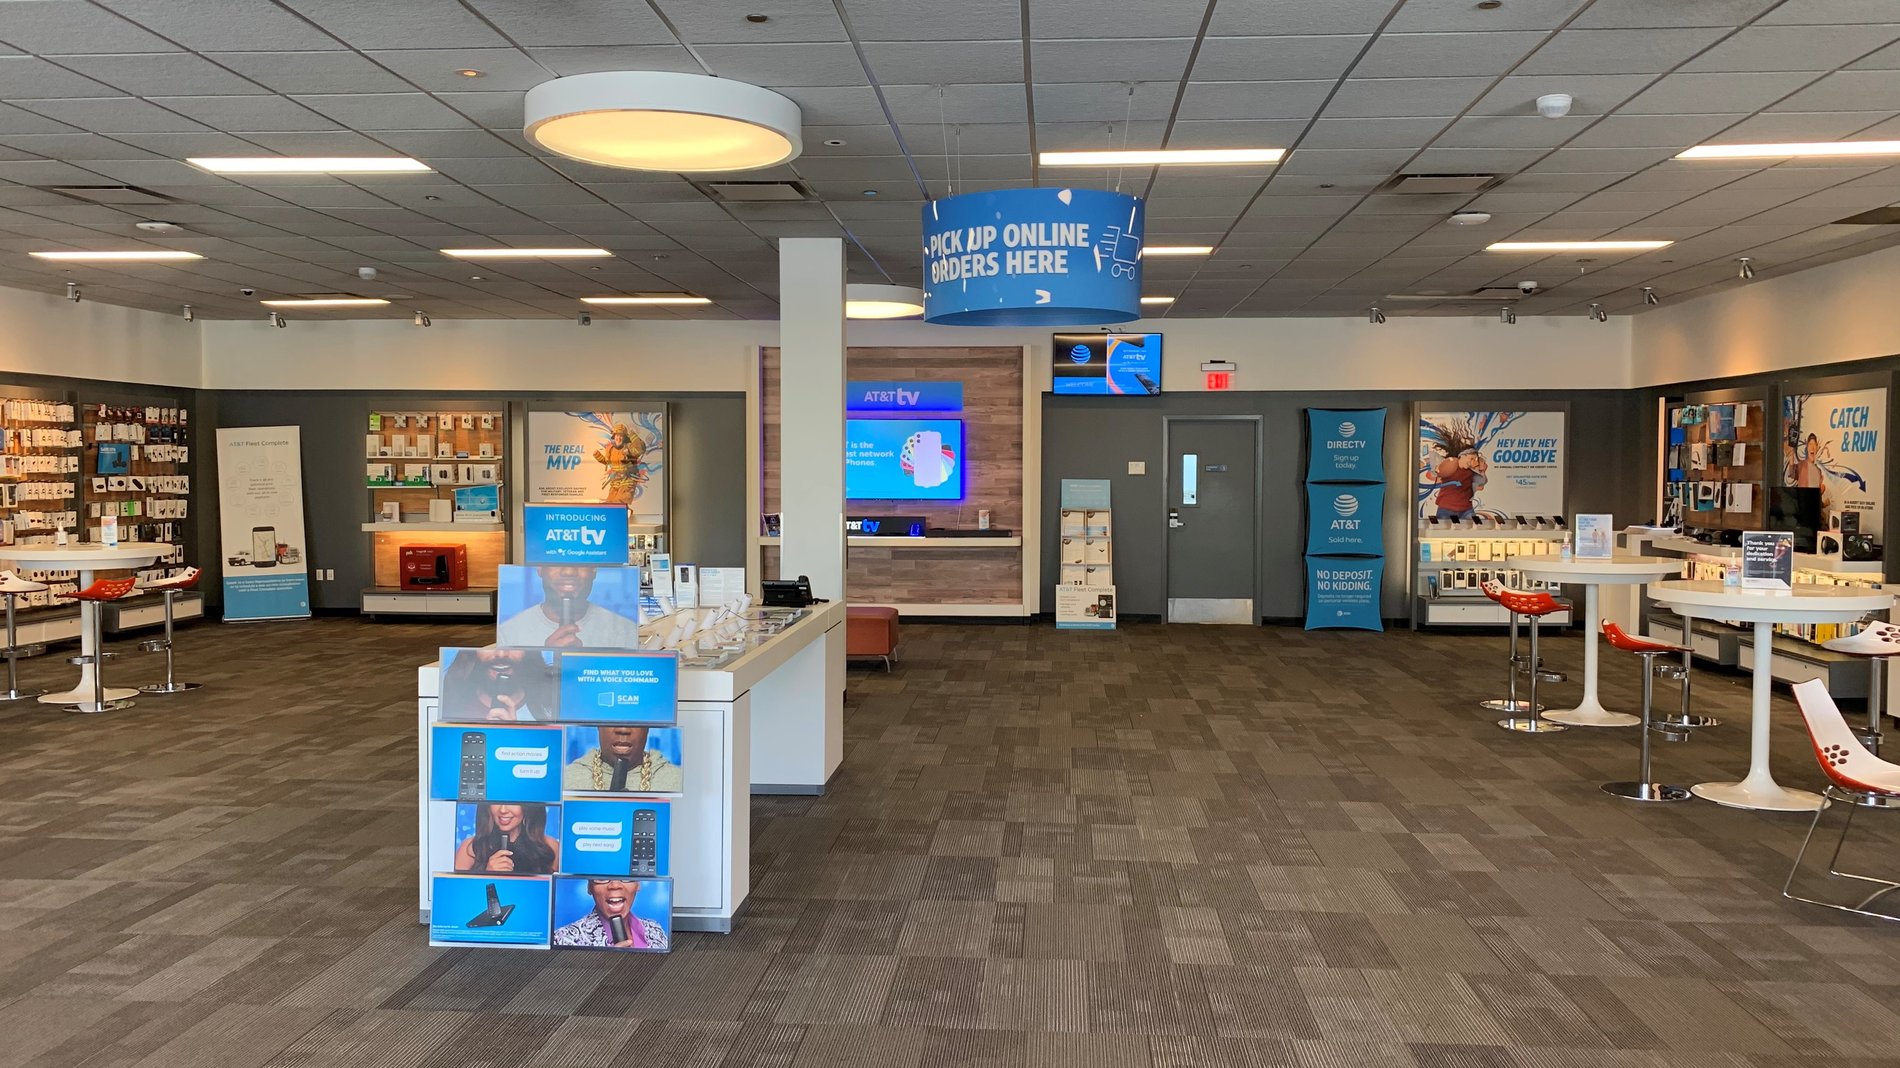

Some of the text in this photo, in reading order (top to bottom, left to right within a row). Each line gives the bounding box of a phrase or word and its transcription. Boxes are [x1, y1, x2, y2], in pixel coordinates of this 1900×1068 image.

[930, 223, 1089, 258] PICK UP ONLINE
[931, 249, 1069, 284] ORDERS HERE
[1207, 372, 1228, 390] EXIT
[864, 388, 920, 406] AT&T tv
[1830, 406, 1870, 429] CATCH
[851, 441, 857, 449] is
[860, 440, 874, 449] the
[1327, 440, 1366, 449] DIRECTV
[1497, 438, 1558, 448] HEY HEY HEY
[1841, 430, 1878, 453] & RUN
[544, 444, 585, 454] THE REAL
[859, 450, 894, 458] network
[1334, 454, 1349, 463] Sign
[1493, 449, 1557, 463] GOODBYE
[547, 455, 582, 471] MVP
[1336, 462, 1357, 470] today.
[545, 513, 607, 522] INTRODUCING
[846, 518, 880, 532] T&T tv
[1330, 519, 1361, 530] AT&T
[546, 525, 607, 545] AT&T tv
[1317, 569, 1374, 581] NO DEPOSIT.
[1317, 580, 1372, 591] NO KIDDING.
